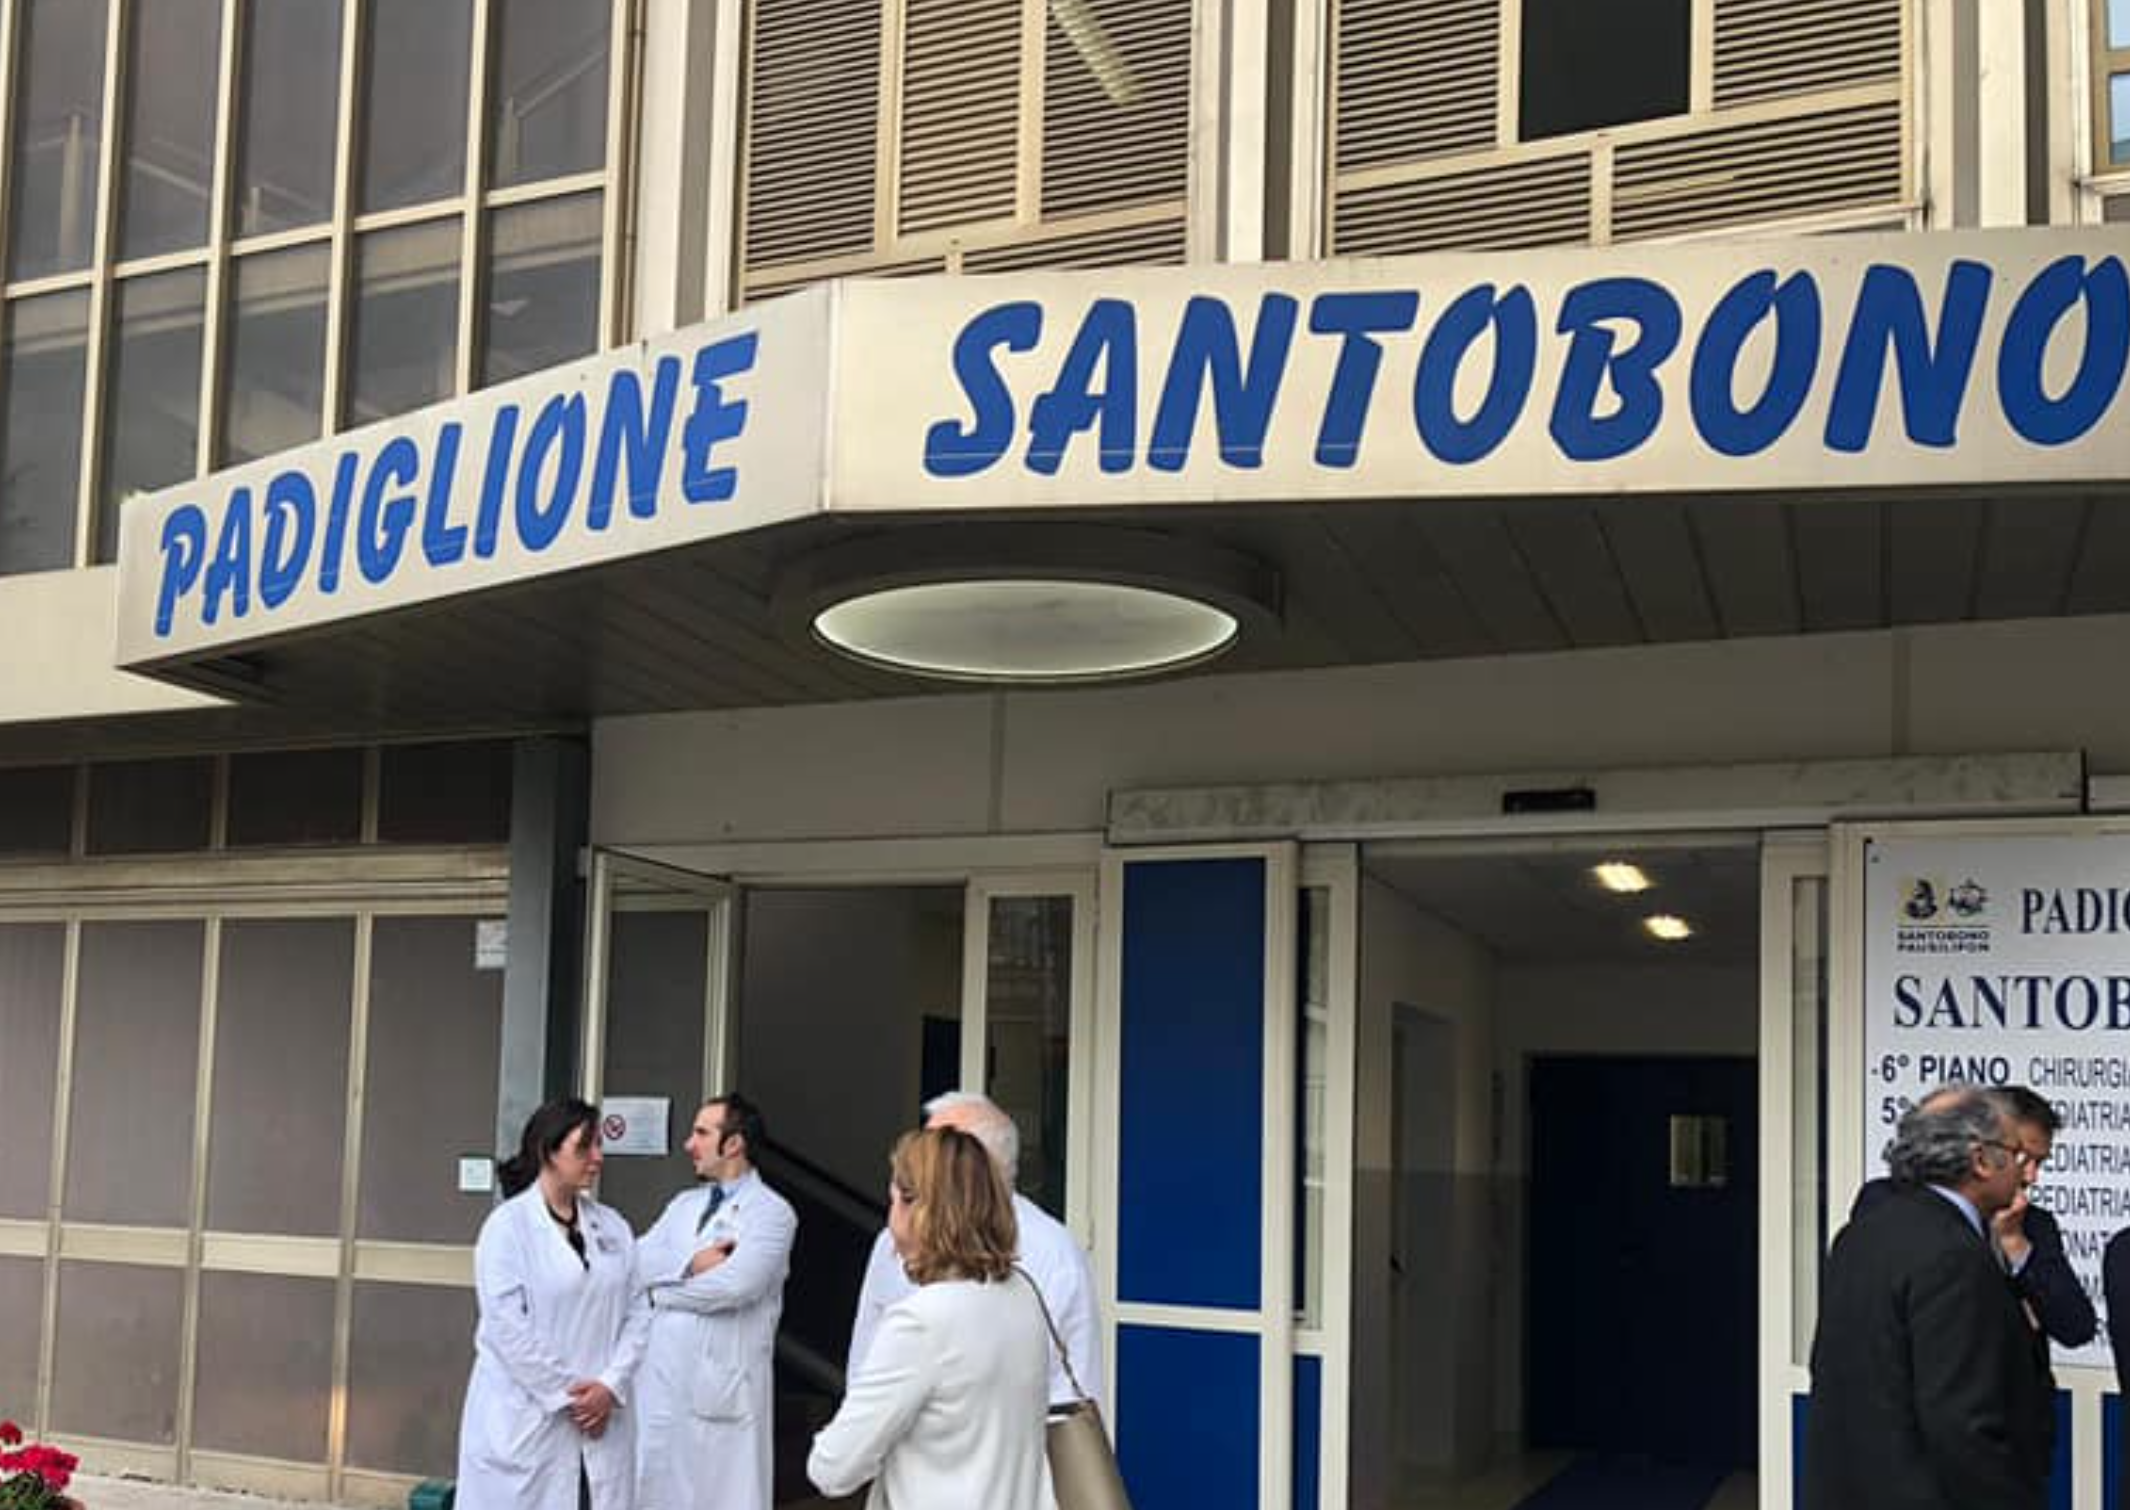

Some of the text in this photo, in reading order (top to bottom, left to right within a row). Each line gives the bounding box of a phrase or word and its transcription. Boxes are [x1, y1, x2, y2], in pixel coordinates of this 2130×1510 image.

[923, 255, 2130, 478] SANTOBONO
[154, 330, 759, 637] PADIGLIONE
[2020, 887, 2130, 934] PADI
[1894, 975, 2130, 1030] SANTOB
[1920, 1055, 2010, 1084] PIANO
